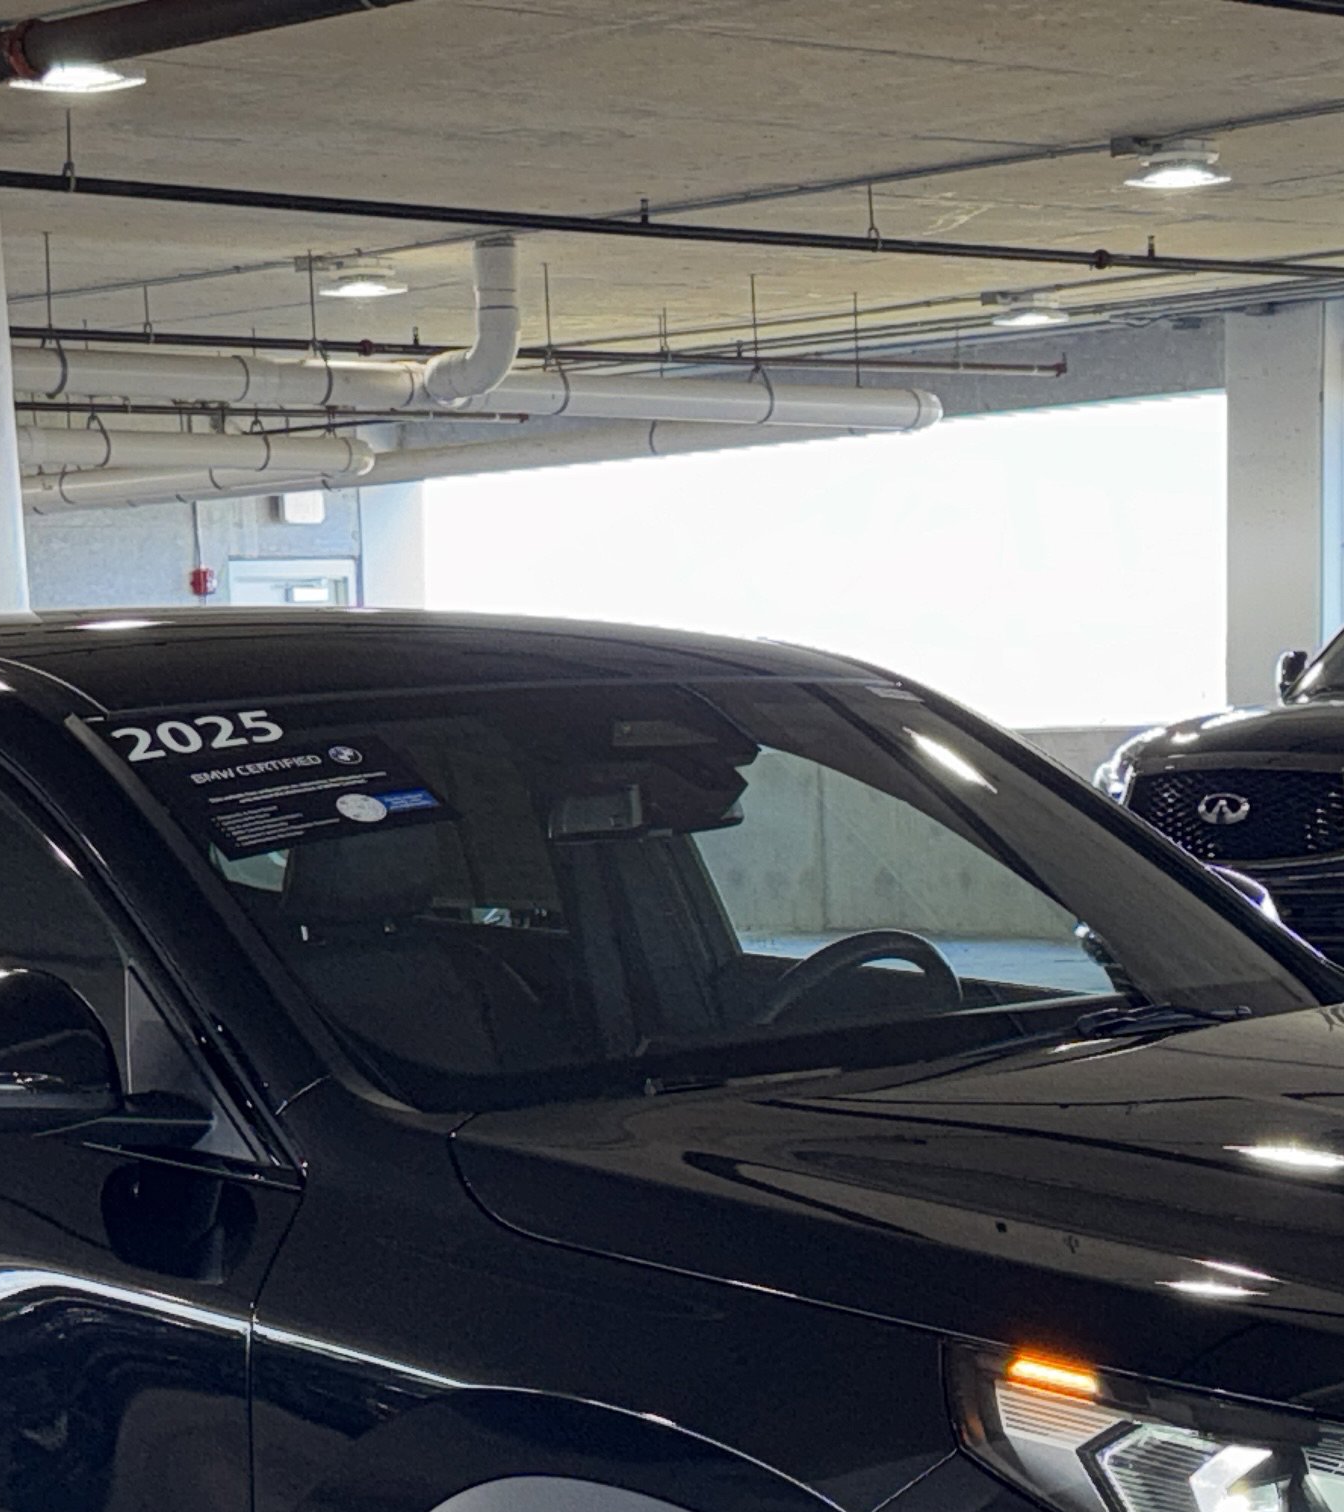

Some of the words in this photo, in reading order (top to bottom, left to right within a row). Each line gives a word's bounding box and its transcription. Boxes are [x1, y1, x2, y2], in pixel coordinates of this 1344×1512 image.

[111, 710, 284, 763] 2025
[190, 768, 234, 785] BMW
[236, 755, 323, 776] CERTIFIED
